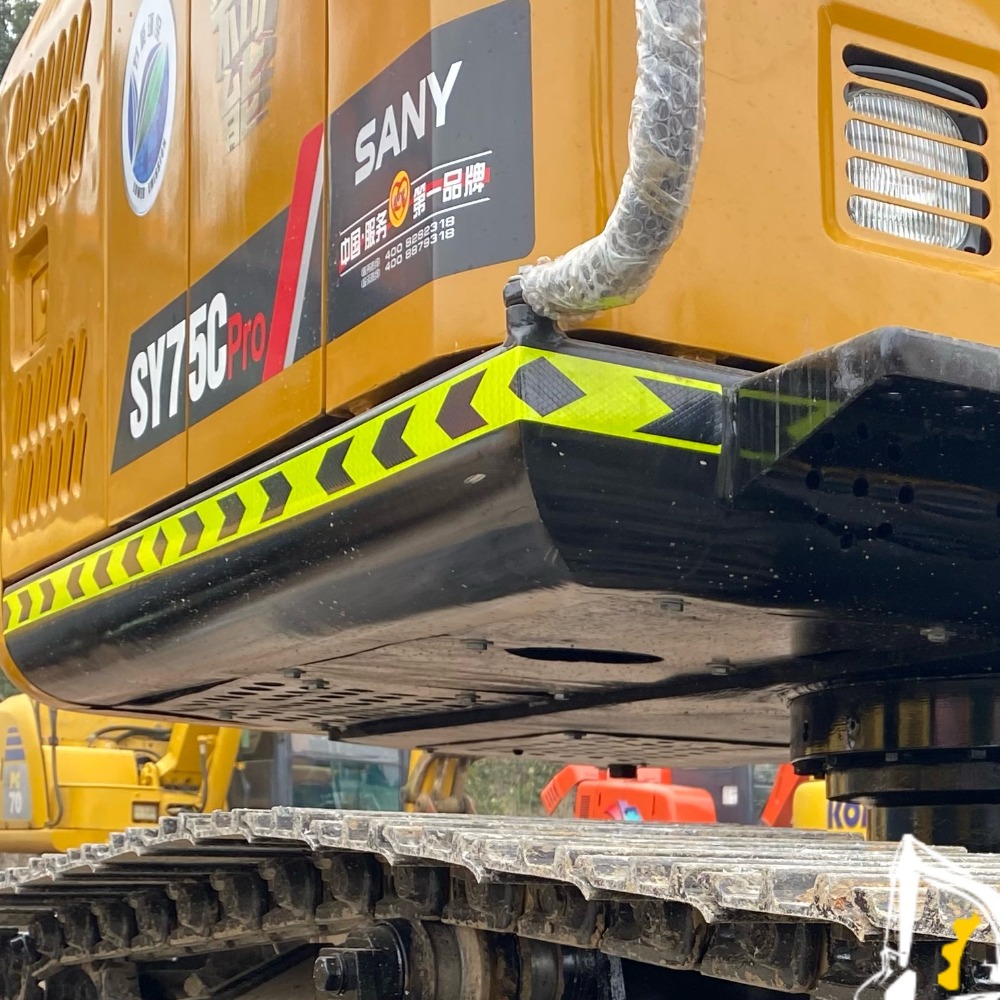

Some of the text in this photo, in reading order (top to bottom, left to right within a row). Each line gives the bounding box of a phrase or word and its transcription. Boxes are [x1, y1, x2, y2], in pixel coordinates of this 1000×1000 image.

[354, 60, 463, 186] SANY
[412, 161, 486, 219] 第一品牌
[384, 215, 455, 260] 400 8282318
[384, 254, 403, 272] 400
[227, 311, 267, 381] Pro
[8, 791, 22, 814] 70
